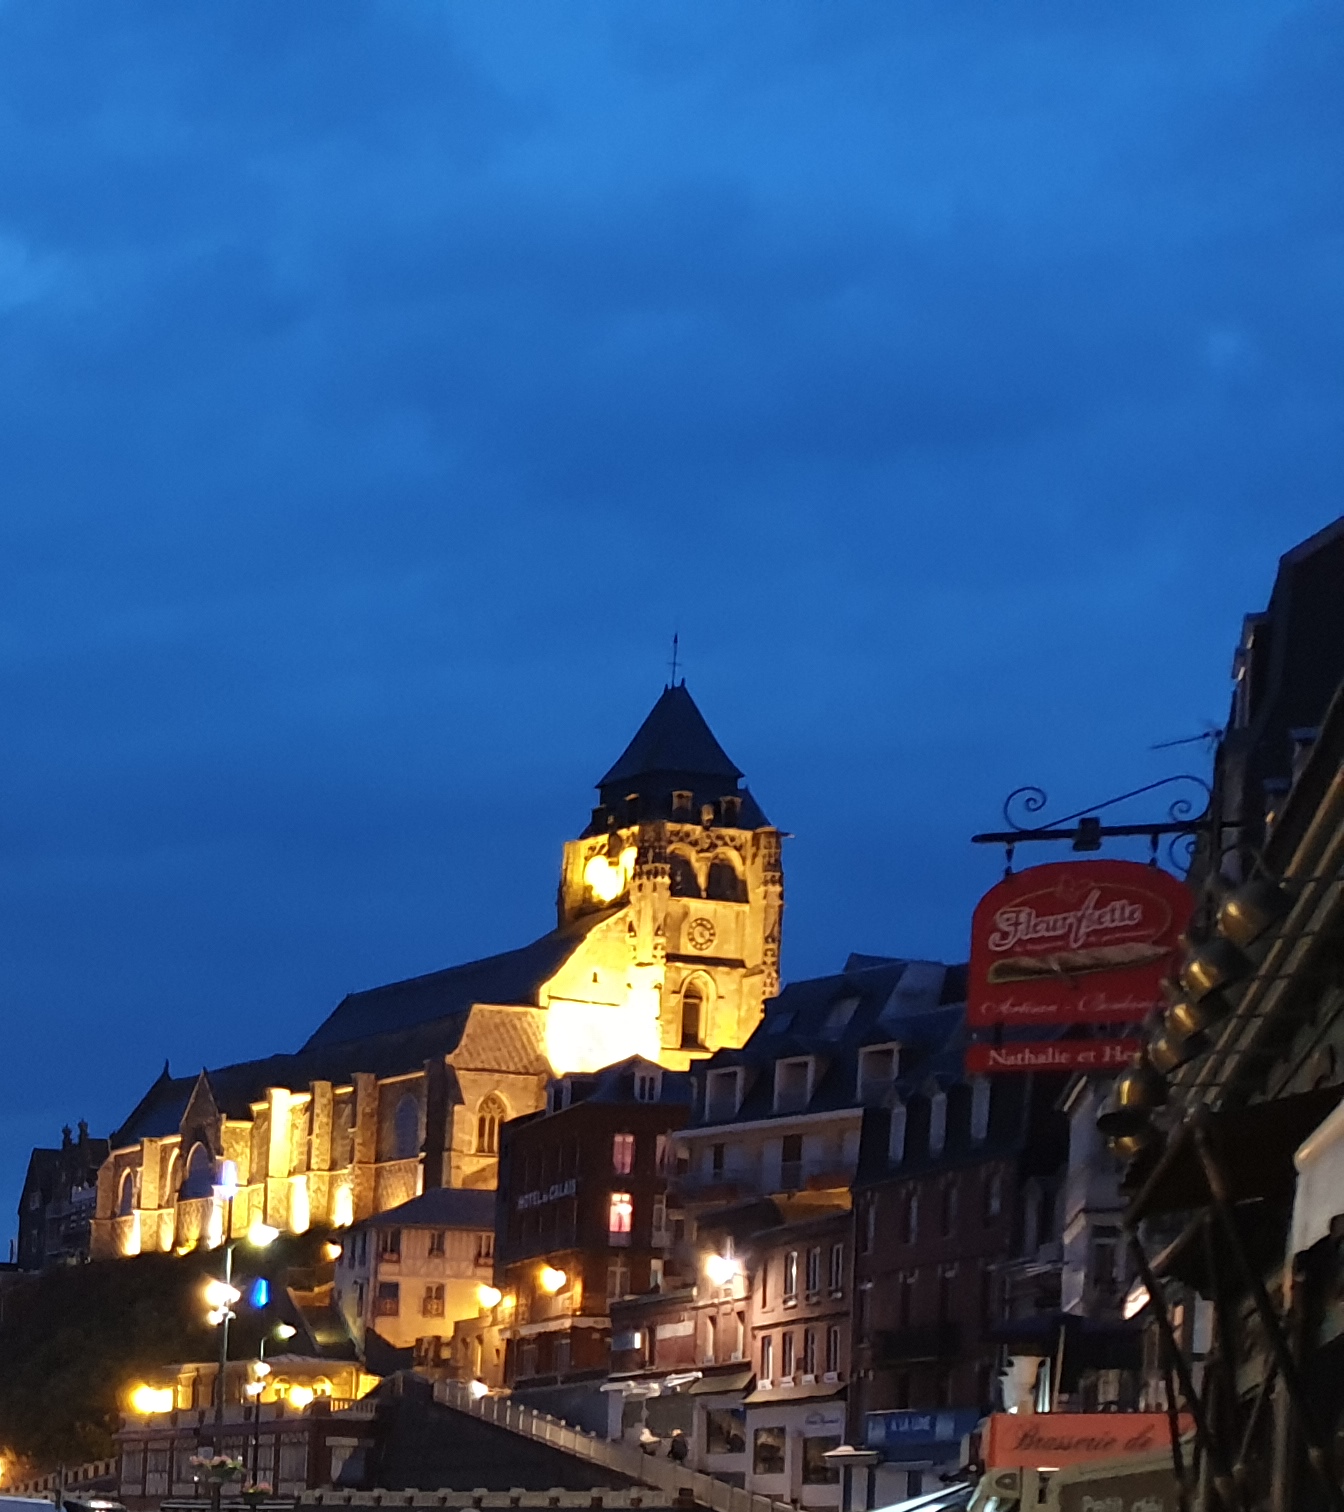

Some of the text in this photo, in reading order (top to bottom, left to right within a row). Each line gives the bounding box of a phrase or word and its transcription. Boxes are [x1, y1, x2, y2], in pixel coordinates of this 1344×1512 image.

[989, 1048, 1069, 1066] Nathalie
[1077, 1050, 1096, 1063] et
[1013, 1422, 1155, 1451] Brasserie de
